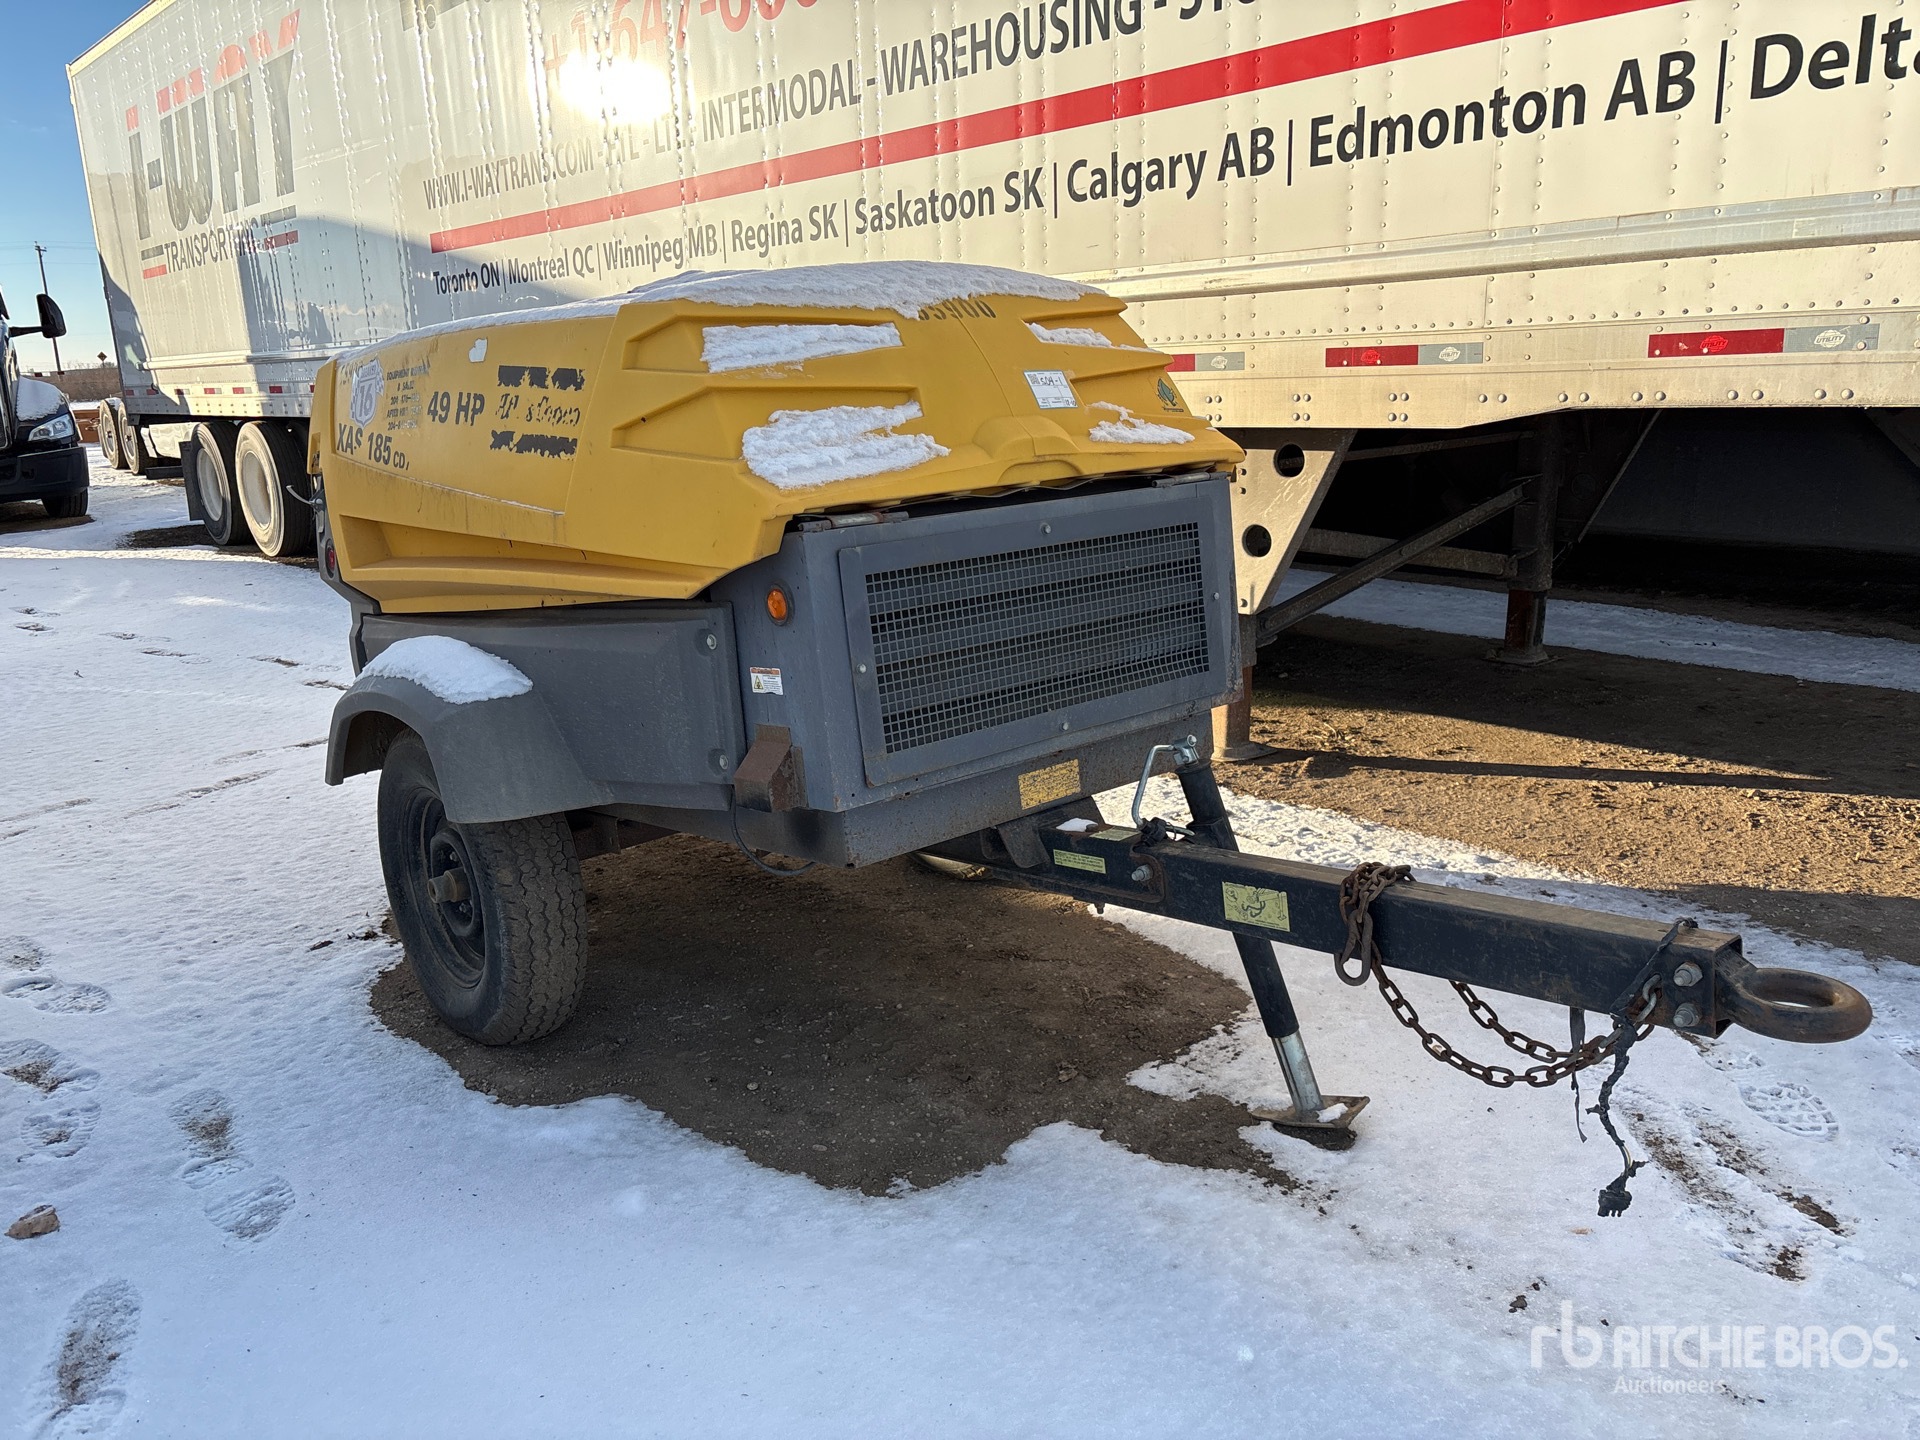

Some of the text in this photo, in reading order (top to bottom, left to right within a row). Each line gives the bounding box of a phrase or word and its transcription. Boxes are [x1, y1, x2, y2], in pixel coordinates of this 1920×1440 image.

[701, 59, 863, 142] INTERMODAL
[880, 0, 1142, 96] WAREHOUSING
[433, 270, 478, 295] Toronto
[480, 263, 500, 288] ON
[508, 248, 570, 285] Montreal
[573, 244, 595, 278] QC
[603, 234, 684, 273] Winnipeg
[688, 224, 718, 258] MB
[731, 213, 803, 258] Regina
[808, 203, 839, 242] SK
[855, 185, 995, 235] Saskatoon
[1004, 167, 1044, 213] SK
[1067, 150, 1207, 208] Calgary
[1217, 127, 1275, 182] AB
[1310, 82, 1586, 167] Edmonton
[1604, 50, 1697, 121] AB
[1750, 13, 1920, 100] Delt
[164, 228, 234, 273] TRANSPORT
[1815, 334, 1845, 344] UTILITY
[359, 383, 373, 418] 16
[427, 390, 451, 424] 49
[455, 391, 485, 427] HP
[367, 432, 393, 466] 185
